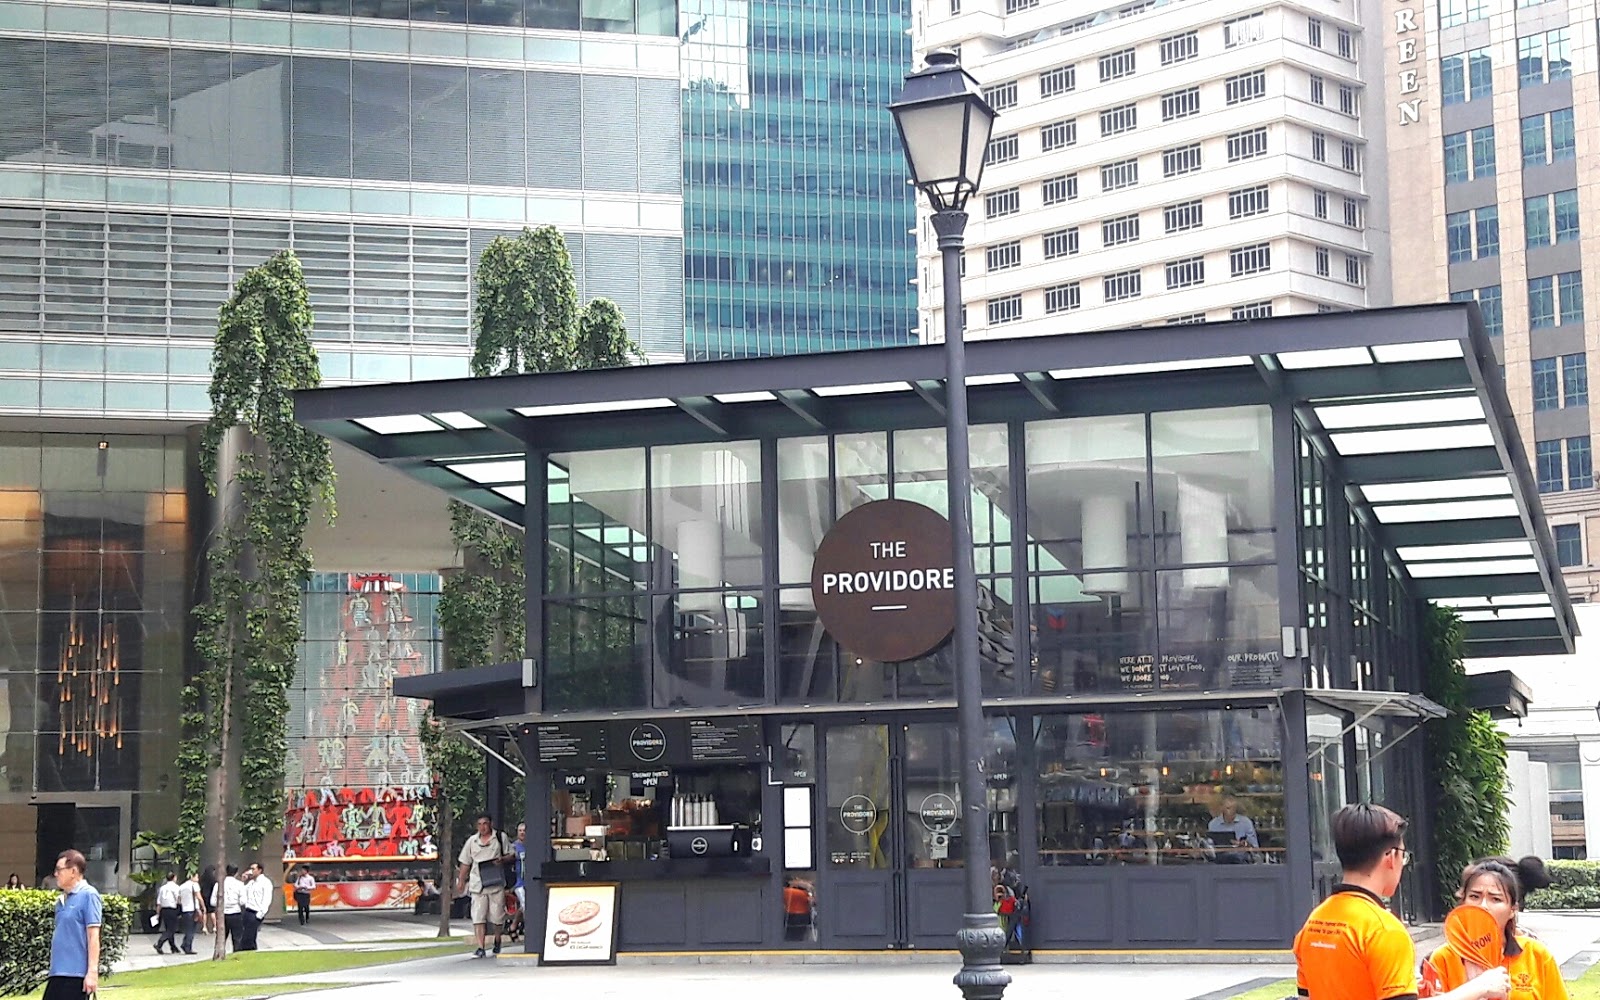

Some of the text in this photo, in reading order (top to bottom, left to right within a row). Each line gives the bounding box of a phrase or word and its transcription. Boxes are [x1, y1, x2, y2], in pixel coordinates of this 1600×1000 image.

[1394, 0, 1422, 126] REEN
[870, 541, 907, 559] THE
[822, 567, 954, 595] PROVIDORE
